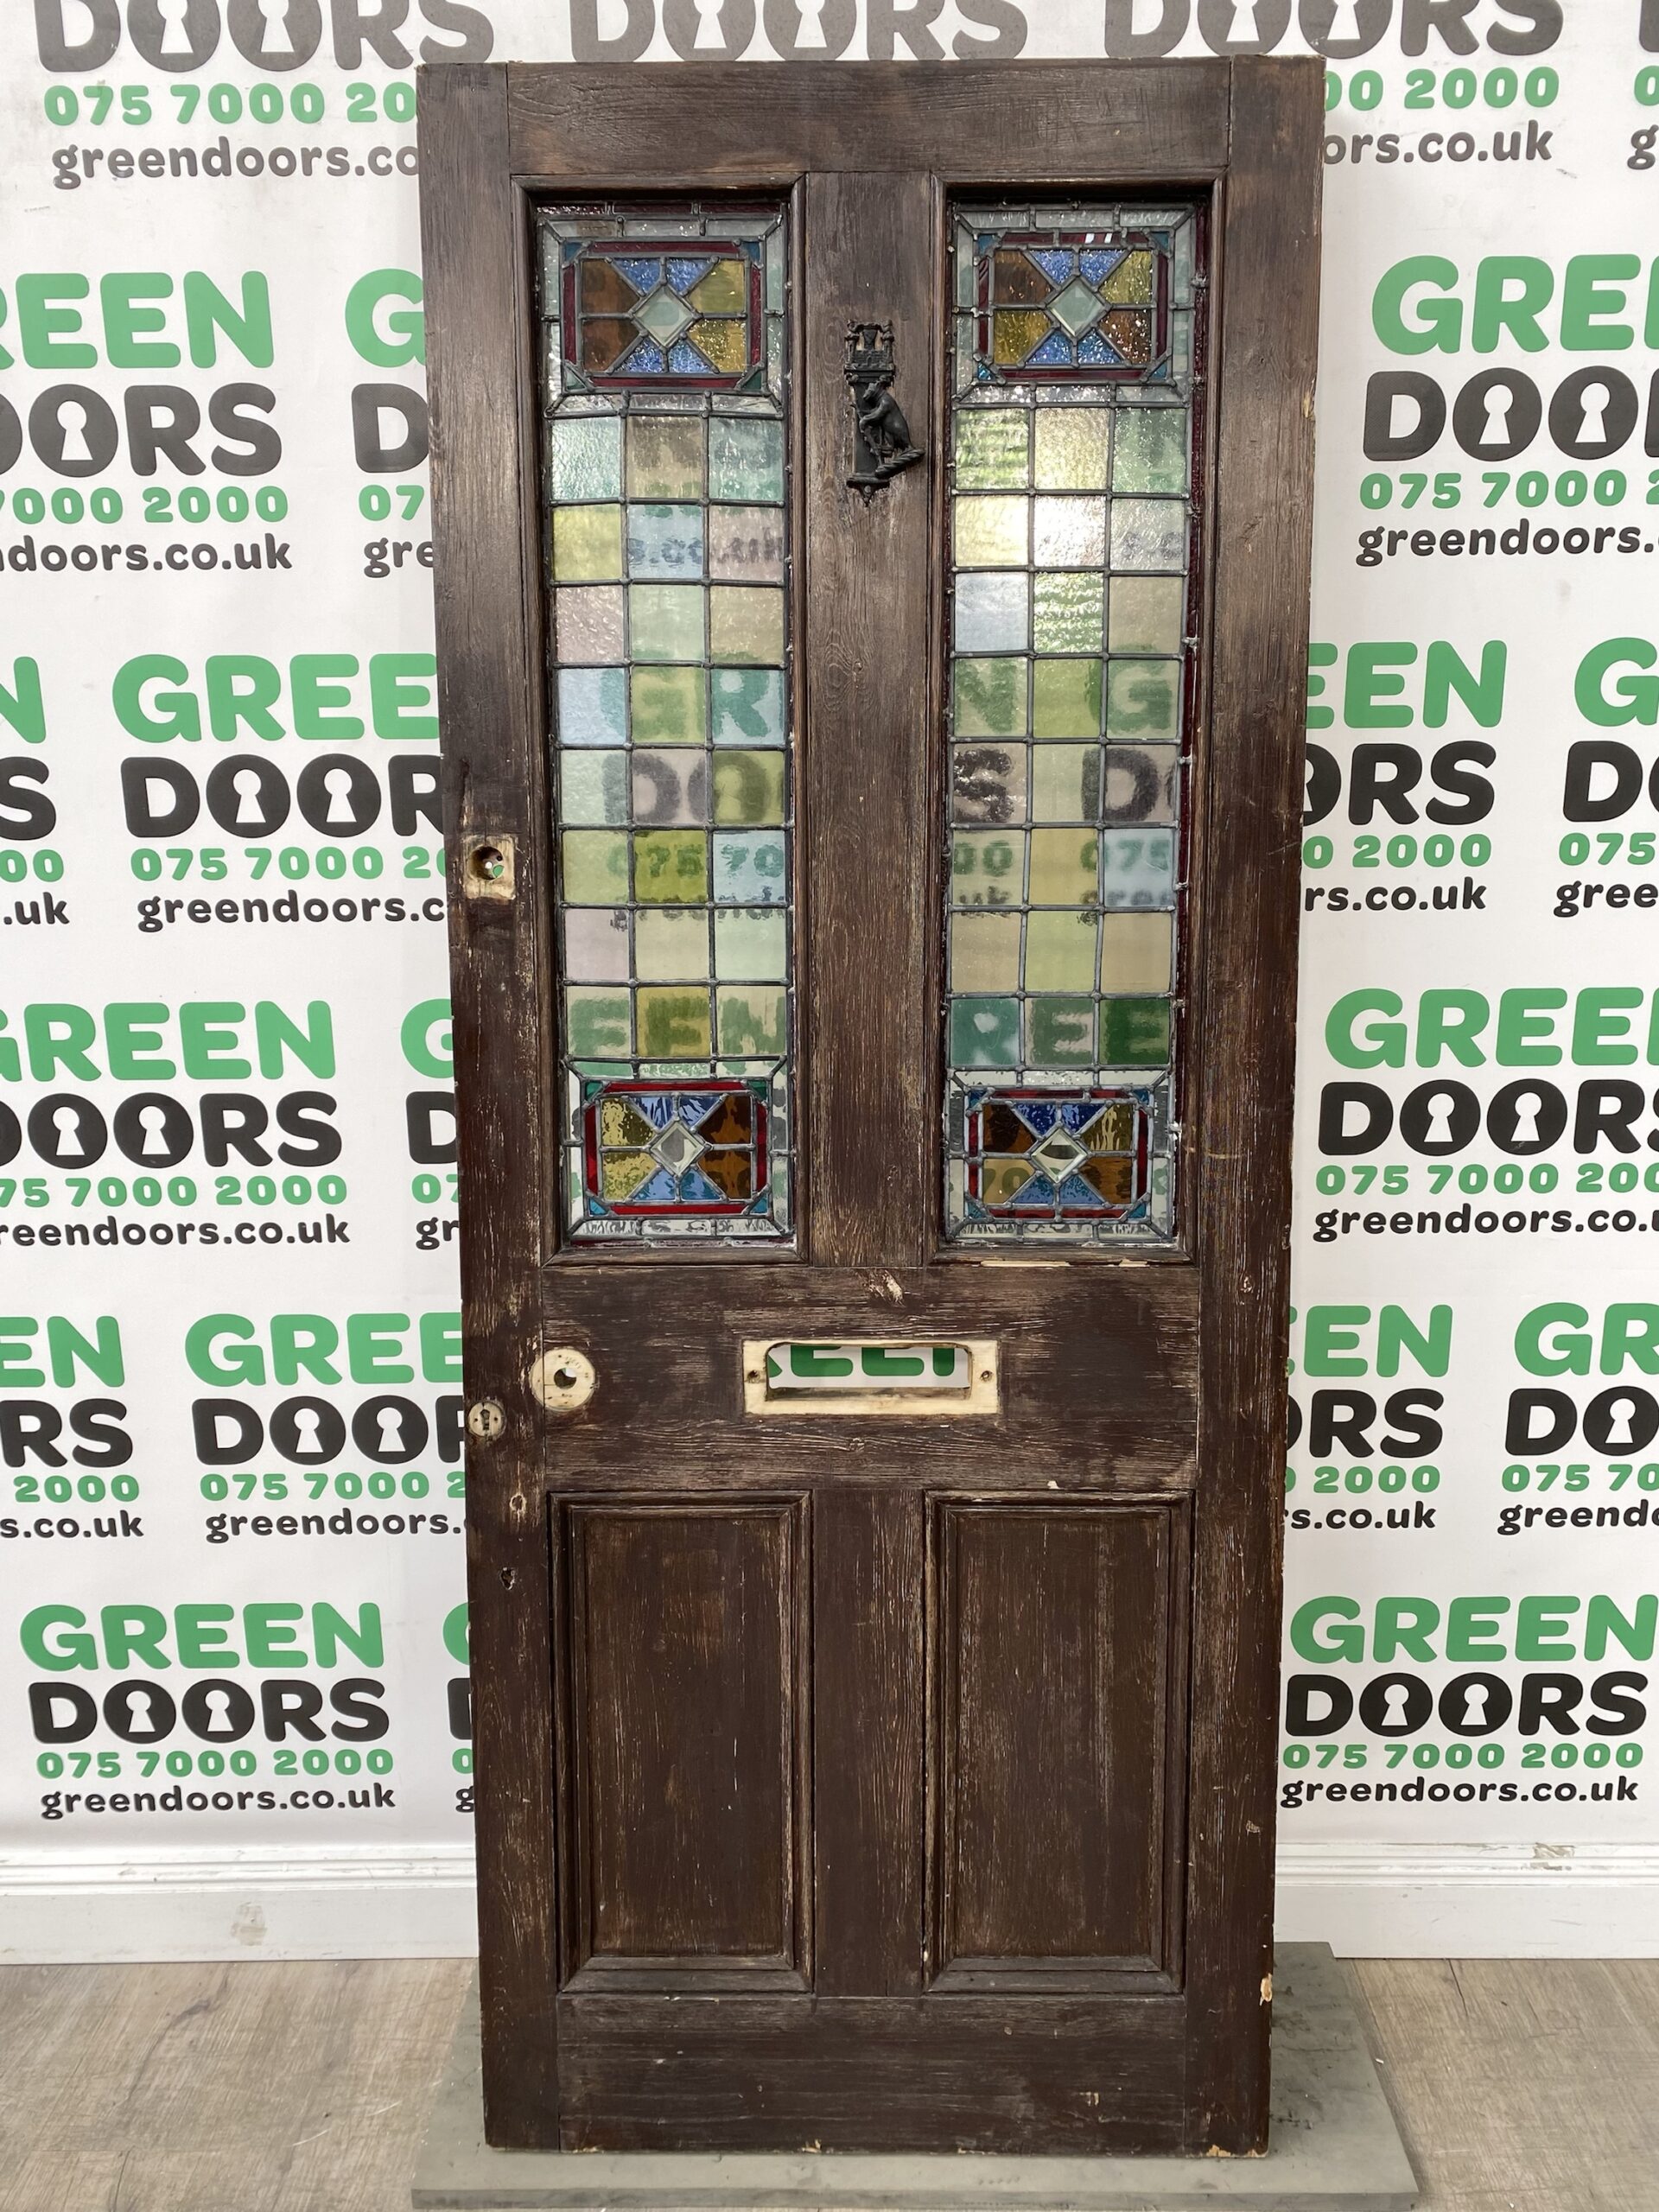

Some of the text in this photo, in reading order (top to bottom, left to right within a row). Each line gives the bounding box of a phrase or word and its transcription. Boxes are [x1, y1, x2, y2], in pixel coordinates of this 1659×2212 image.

[34, 0, 494, 73] DOORS
[570, 0, 1027, 60] DOORS
[1103, 0, 1564, 59] DOORS
[44, 84, 152, 126] 075
[170, 83, 325, 124] 7000
[1404, 67, 1560, 110] 2000
[52, 136, 418, 190] greendoors.co
[0, 270, 274, 369] EEN
[1371, 254, 1659, 355] GRE
[0, 382, 282, 478] ORS
[1363, 365, 1659, 461] DOO
[0, 486, 288, 524] 000 2000
[1359, 472, 1462, 510] 075
[1481, 469, 1627, 507] 7000
[0, 532, 292, 571] doors.co.uk
[1356, 518, 1659, 567] greendoors.
[1562, 741, 1659, 823] D
[130, 848, 226, 881] 075
[245, 846, 383, 880] 7000
[1353, 834, 1491, 868] 2000
[1559, 832, 1656, 867] 075
[1325, 986, 1659, 1070] GREE
[1317, 1078, 1659, 1157] DOOR
[66, 1176, 197, 1206] 7000
[215, 1174, 346, 1205] 2000
[1315, 1164, 1409, 1197] 075
[1427, 1163, 1559, 1195] 7000
[1287, 1305, 1452, 1376] EN
[1286, 1388, 1443, 1458] RS
[15, 1476, 139, 1503] 2000
[200, 1472, 288, 1501] 075
[303, 1471, 429, 1499] 7000
[1313, 1465, 1440, 1493] 2000
[1502, 1465, 1590, 1492] 075
[206, 1509, 466, 1543] greendoors.
[1285, 1502, 1435, 1529] s.co.uk
[20, 1603, 384, 1671] GREEN
[1290, 1594, 1657, 1662] GREEN
[29, 1678, 389, 1744] DOORS
[1286, 1672, 1647, 1737] DOORS
[37, 1749, 393, 1779] 075 7000 2000
[1283, 1743, 1643, 1769] 075 7000 2000
[41, 1783, 396, 1820] greendoors.co.uk
[1281, 1777, 1638, 1808] greendoors.co.uk
